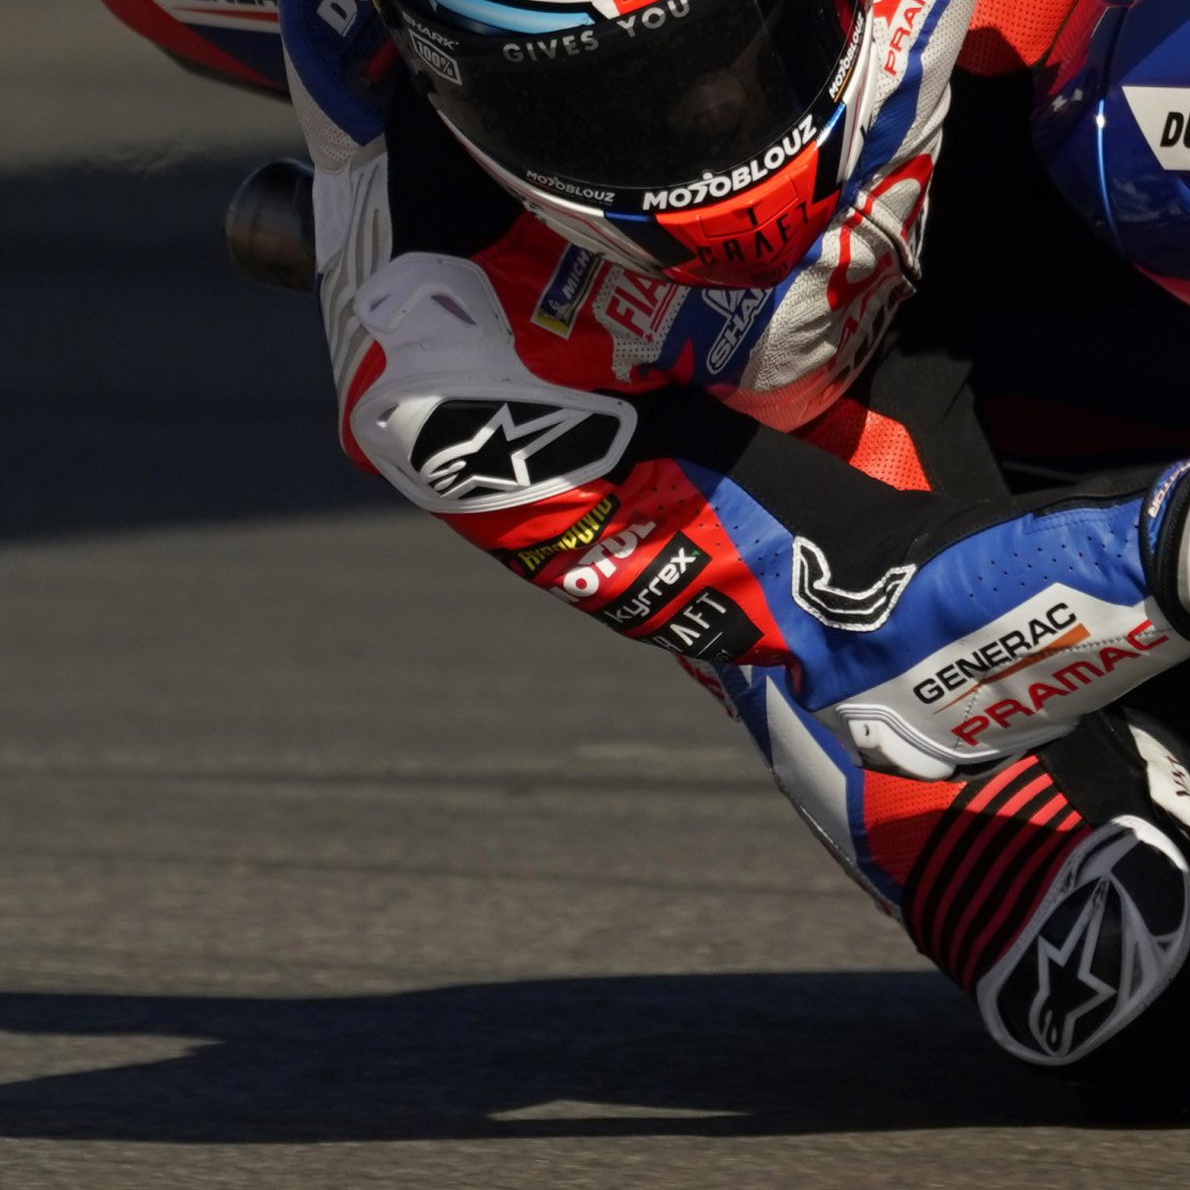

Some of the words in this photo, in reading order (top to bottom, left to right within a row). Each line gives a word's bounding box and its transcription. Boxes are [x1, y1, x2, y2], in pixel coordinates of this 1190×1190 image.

[503, 29, 599, 64] GIVES
[642, 114, 817, 211] MOTOBLOUZ
[604, 270, 670, 338] FIA
[604, 547, 696, 623] kyrrex
[653, 592, 727, 653] RAFT
[912, 602, 1077, 706] GENERAC
[952, 620, 1172, 746] PRAMAC
